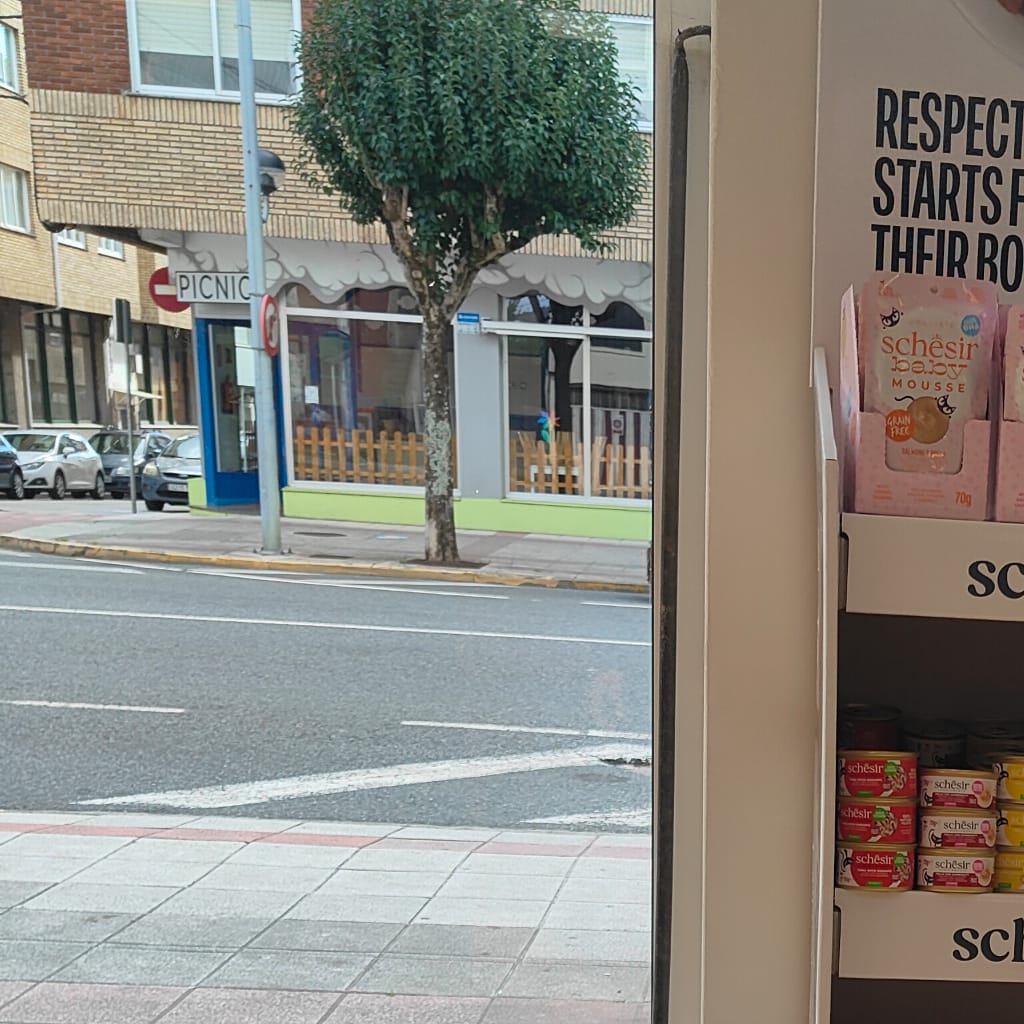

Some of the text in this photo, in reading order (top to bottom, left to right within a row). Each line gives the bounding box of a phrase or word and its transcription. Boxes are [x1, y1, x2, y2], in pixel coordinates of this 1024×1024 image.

[873, 156, 1003, 225] STARTS
[891, 355, 968, 380] baby
[891, 377, 966, 393] MOUSSE
[887, 415, 911, 427] GRAIN
[890, 426, 910, 437] FREE
[955, 491, 972, 507] 70g
